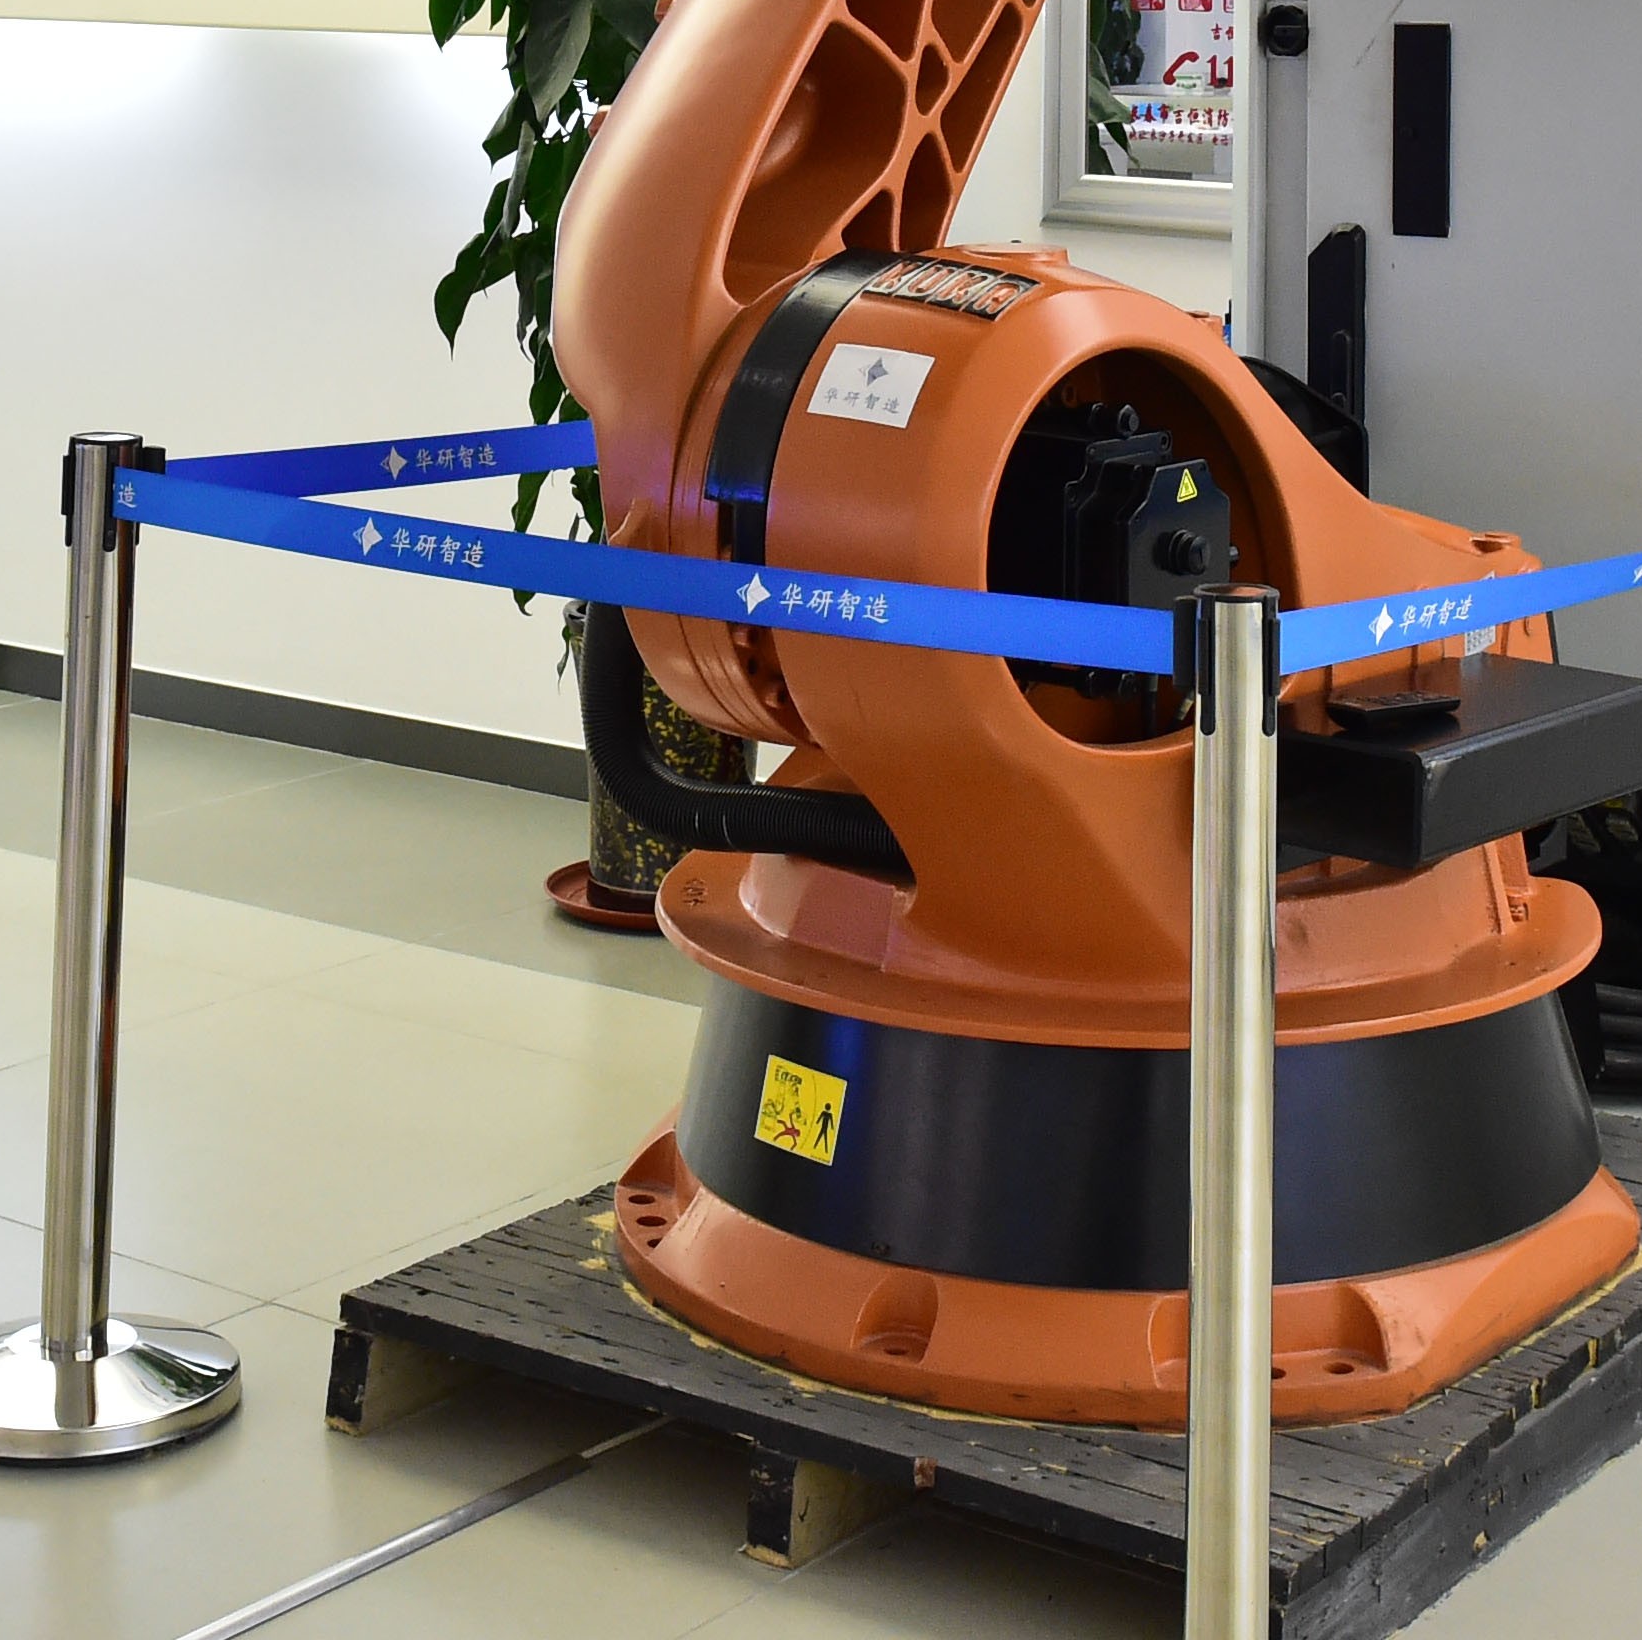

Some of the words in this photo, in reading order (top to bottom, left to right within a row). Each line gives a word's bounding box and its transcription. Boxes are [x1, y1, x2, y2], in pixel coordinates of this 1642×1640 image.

[867, 259, 1030, 317] KUKA
[823, 386, 901, 416] 华研智造
[414, 442, 499, 474] 华研智造
[389, 526, 487, 570] 华研智造
[779, 581, 892, 626] 华研智造
[1397, 592, 1475, 636] 华研智造
